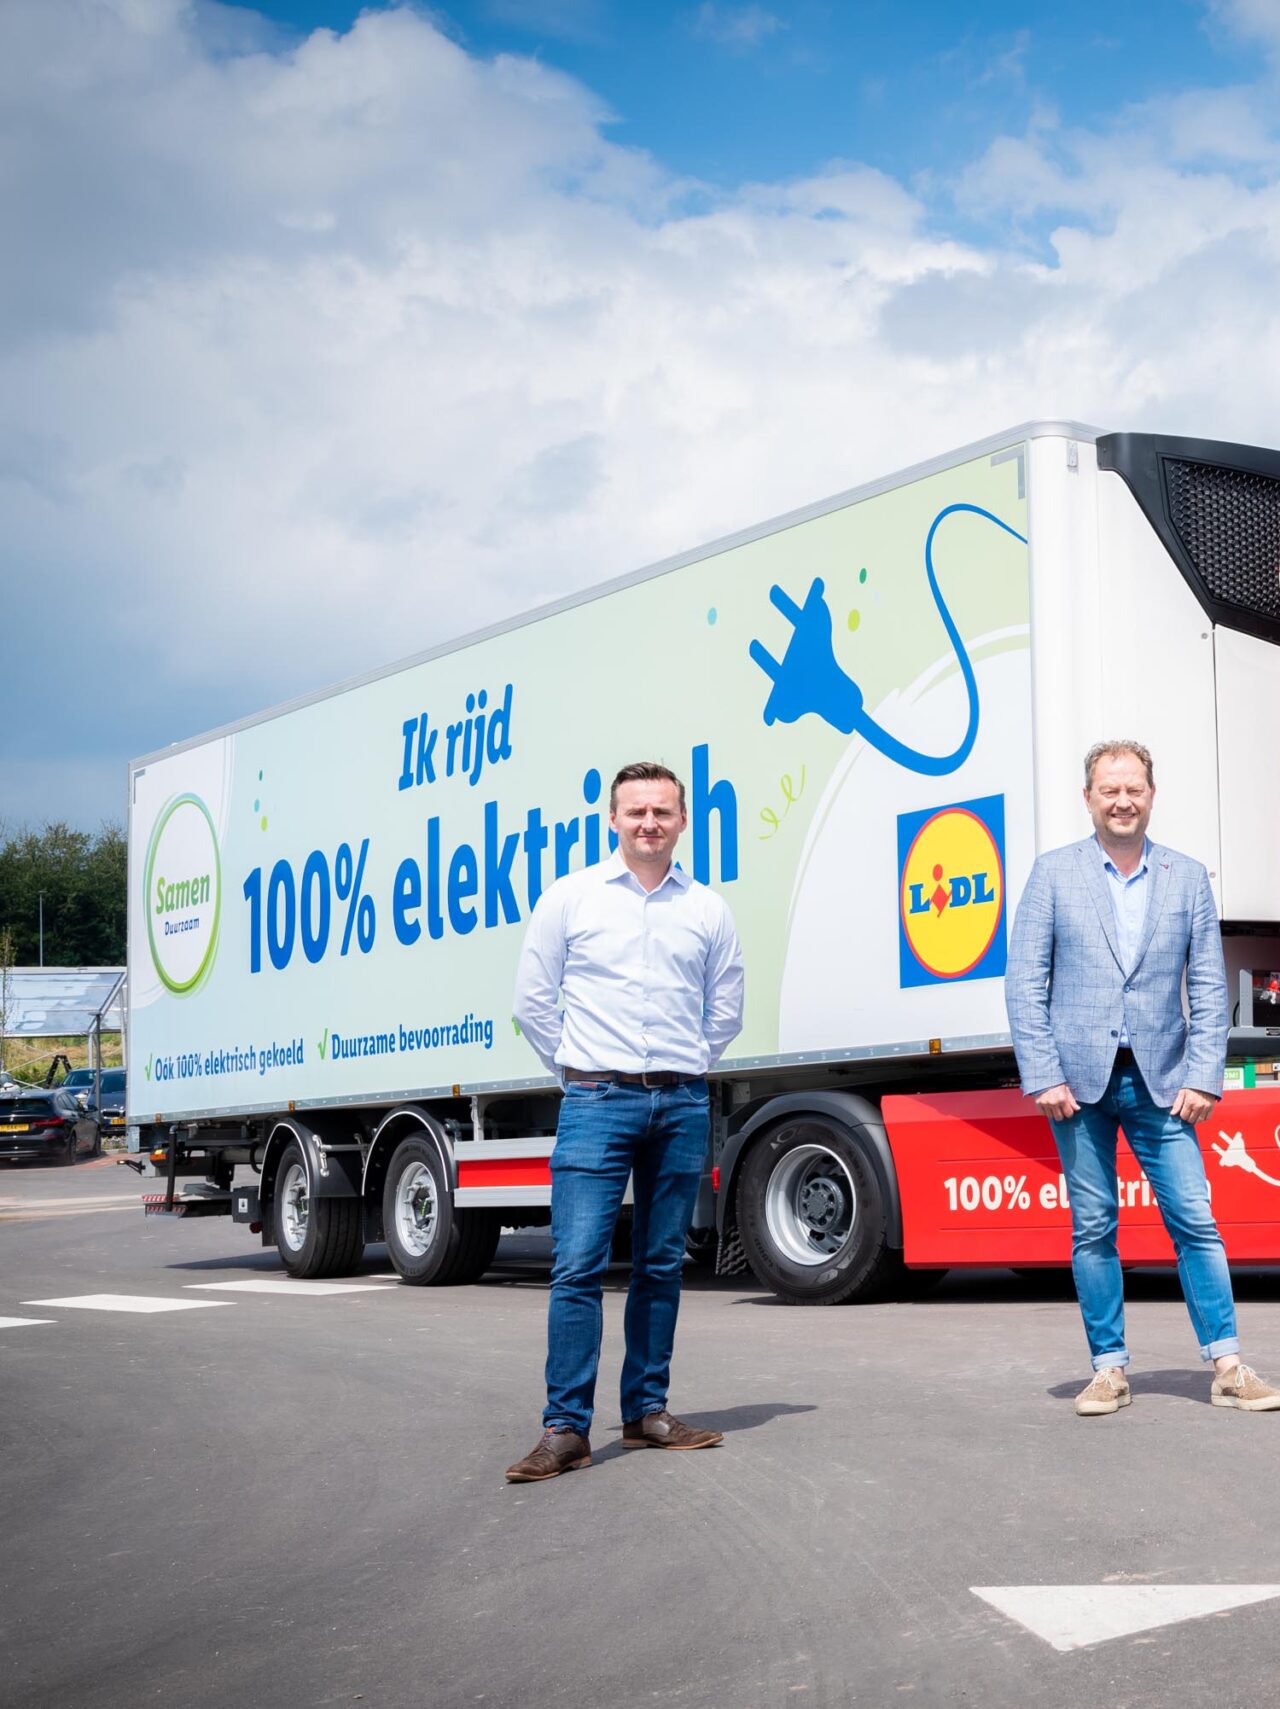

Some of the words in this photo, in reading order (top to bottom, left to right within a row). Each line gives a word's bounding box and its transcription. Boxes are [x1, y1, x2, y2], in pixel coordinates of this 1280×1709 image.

[398, 712, 438, 791] Ik
[446, 683, 513, 786] rijd
[243, 838, 376, 974] 100%
[393, 743, 738, 946] elektrih
[156, 874, 210, 914] Samen
[165, 917, 200, 936] Duurzaam
[332, 1032, 395, 1059] Duurzame
[399, 1013, 493, 1049] bevoorrading
[176, 1053, 202, 1079] 100%
[205, 1045, 256, 1075] elektrisch
[259, 1038, 304, 1076] gekoeld
[943, 1175, 1031, 1211] 100%
